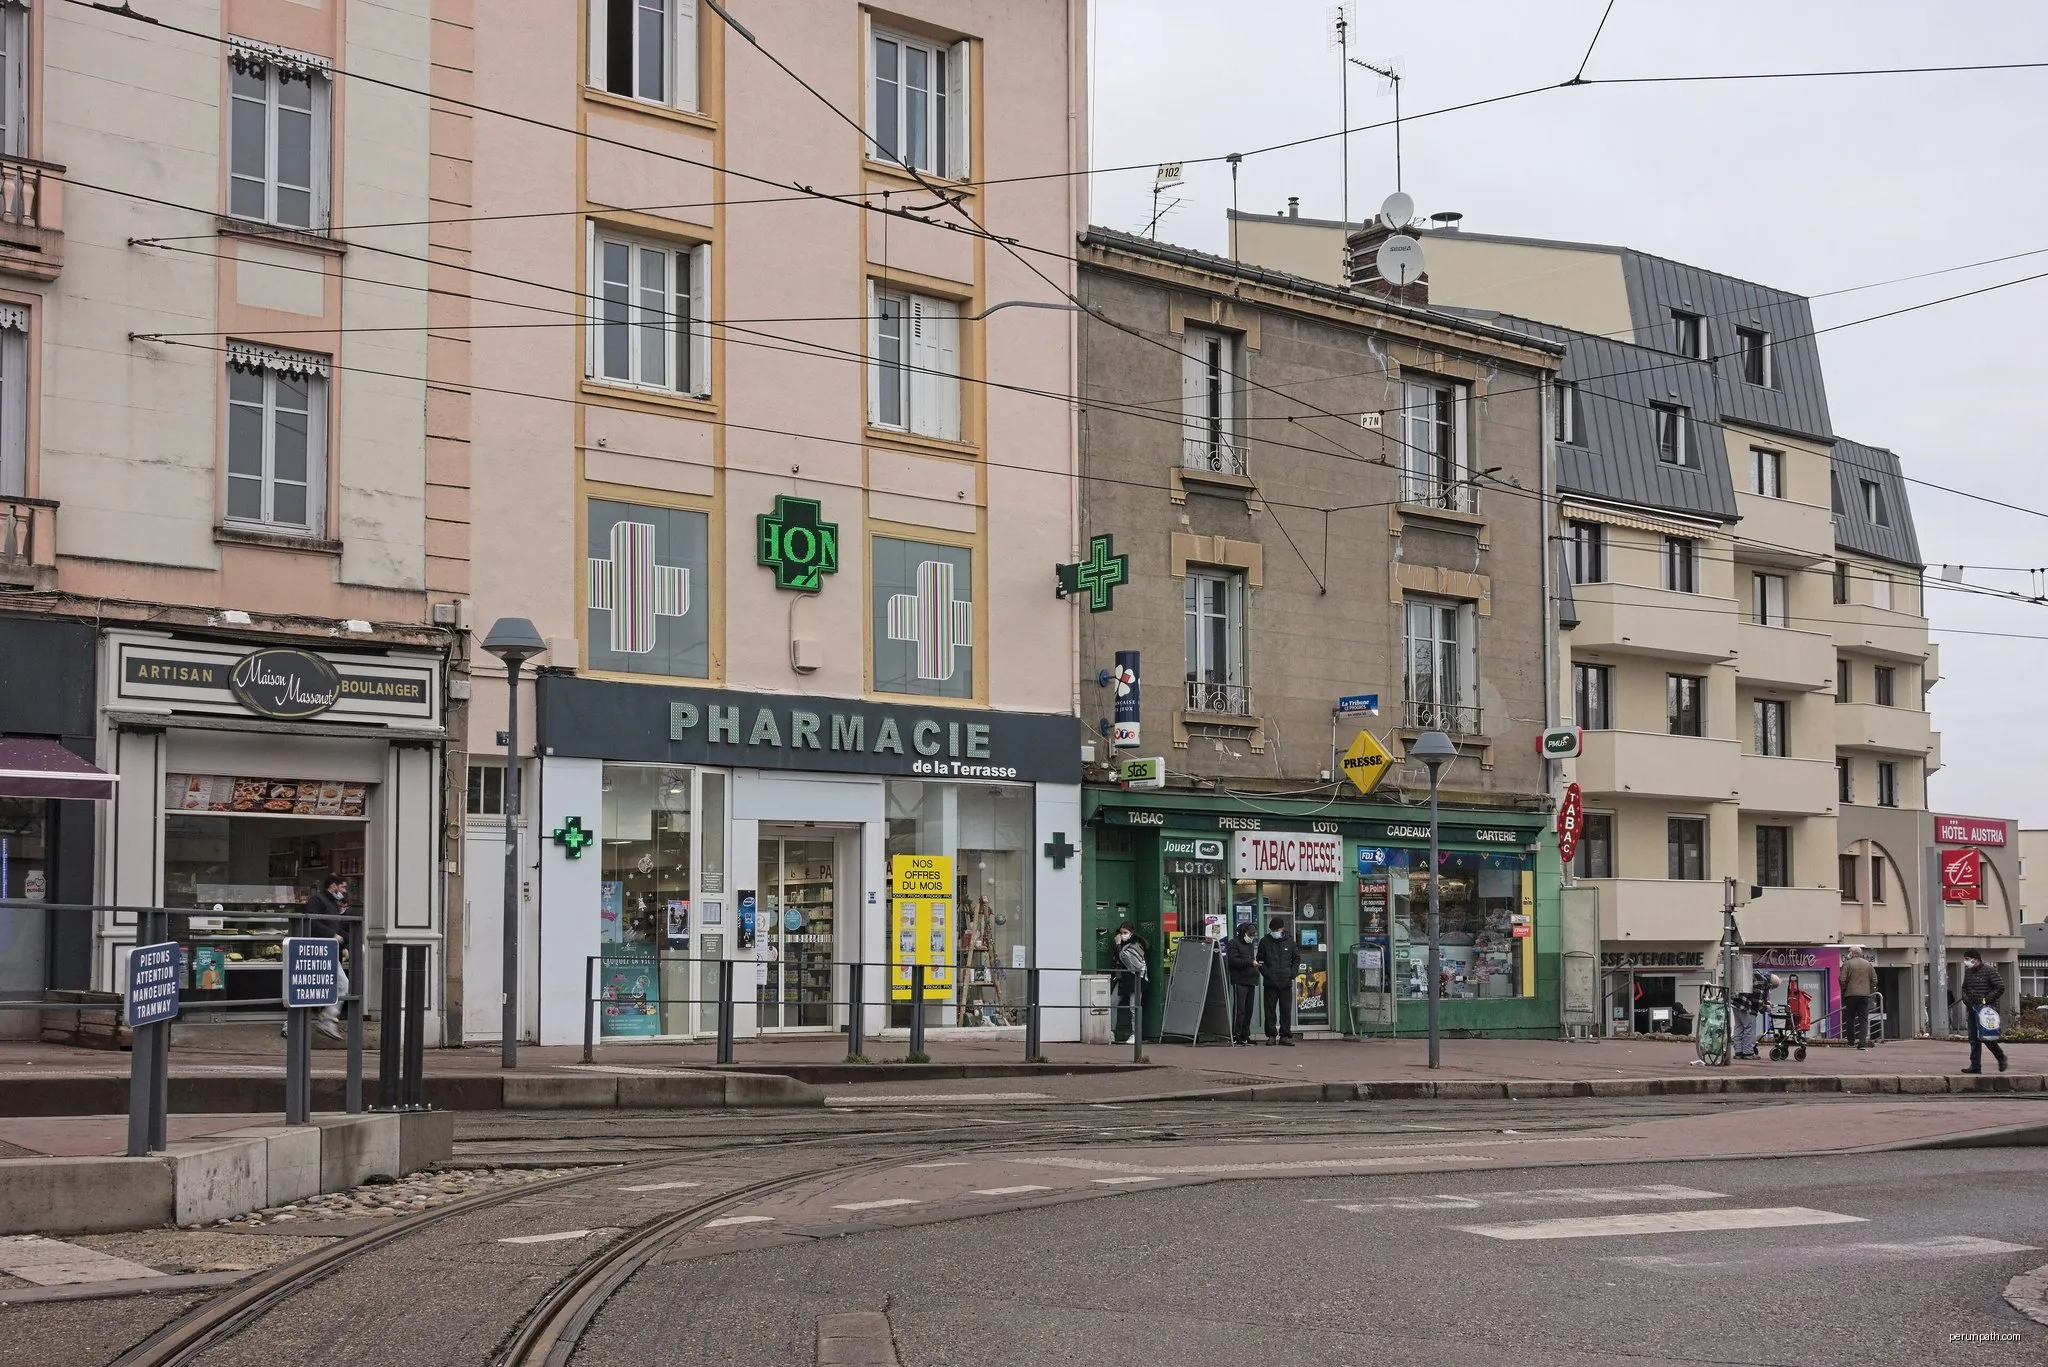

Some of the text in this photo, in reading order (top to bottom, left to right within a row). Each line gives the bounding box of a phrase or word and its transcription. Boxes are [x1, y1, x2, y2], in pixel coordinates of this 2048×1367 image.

[1157, 167, 1180, 178] P 102
[138, 664, 213, 682] ARTISAN
[236, 655, 286, 688] Maison
[275, 673, 333, 706] Massenet
[341, 680, 419, 697] BOULANGER
[669, 702, 991, 759] PHARMACIE
[1547, 739, 1563, 748] PMU
[1343, 754, 1383, 769] PRESSE
[912, 760, 1017, 778] de la Terrasse
[1127, 761, 1148, 777] stas
[1128, 811, 1164, 825] TABAC
[1219, 817, 1261, 830] PRESSE
[1562, 793, 1576, 853] TABAC
[1312, 821, 1338, 833] LOTO
[1387, 825, 1431, 838] CADEAUX
[1476, 829, 1517, 841] CARTERIE
[1941, 825, 2004, 843] HOTEL AUSTRIA
[1164, 840, 1194, 853] Jouez!
[1252, 840, 1336, 873] TABAC PRESSE
[1361, 852, 1373, 860] FDJ
[912, 859, 933, 868] NOS
[1174, 861, 1214, 874] LOTO
[904, 870, 941, 880] OFFRES
[902, 881, 943, 891] DU MOIS
[1370, 884, 1386, 892] Point
[299, 945, 328, 957] PIETONS
[140, 950, 170, 968] PIETONS
[295, 960, 332, 971] ATTENTION
[136, 966, 174, 985] ATTENTION
[292, 974, 334, 985] MANOEUVRE
[133, 982, 176, 1003] MANOEUVRE
[296, 988, 330, 1000] TRAMWAY
[137, 999, 172, 1019] TRAMWAY
